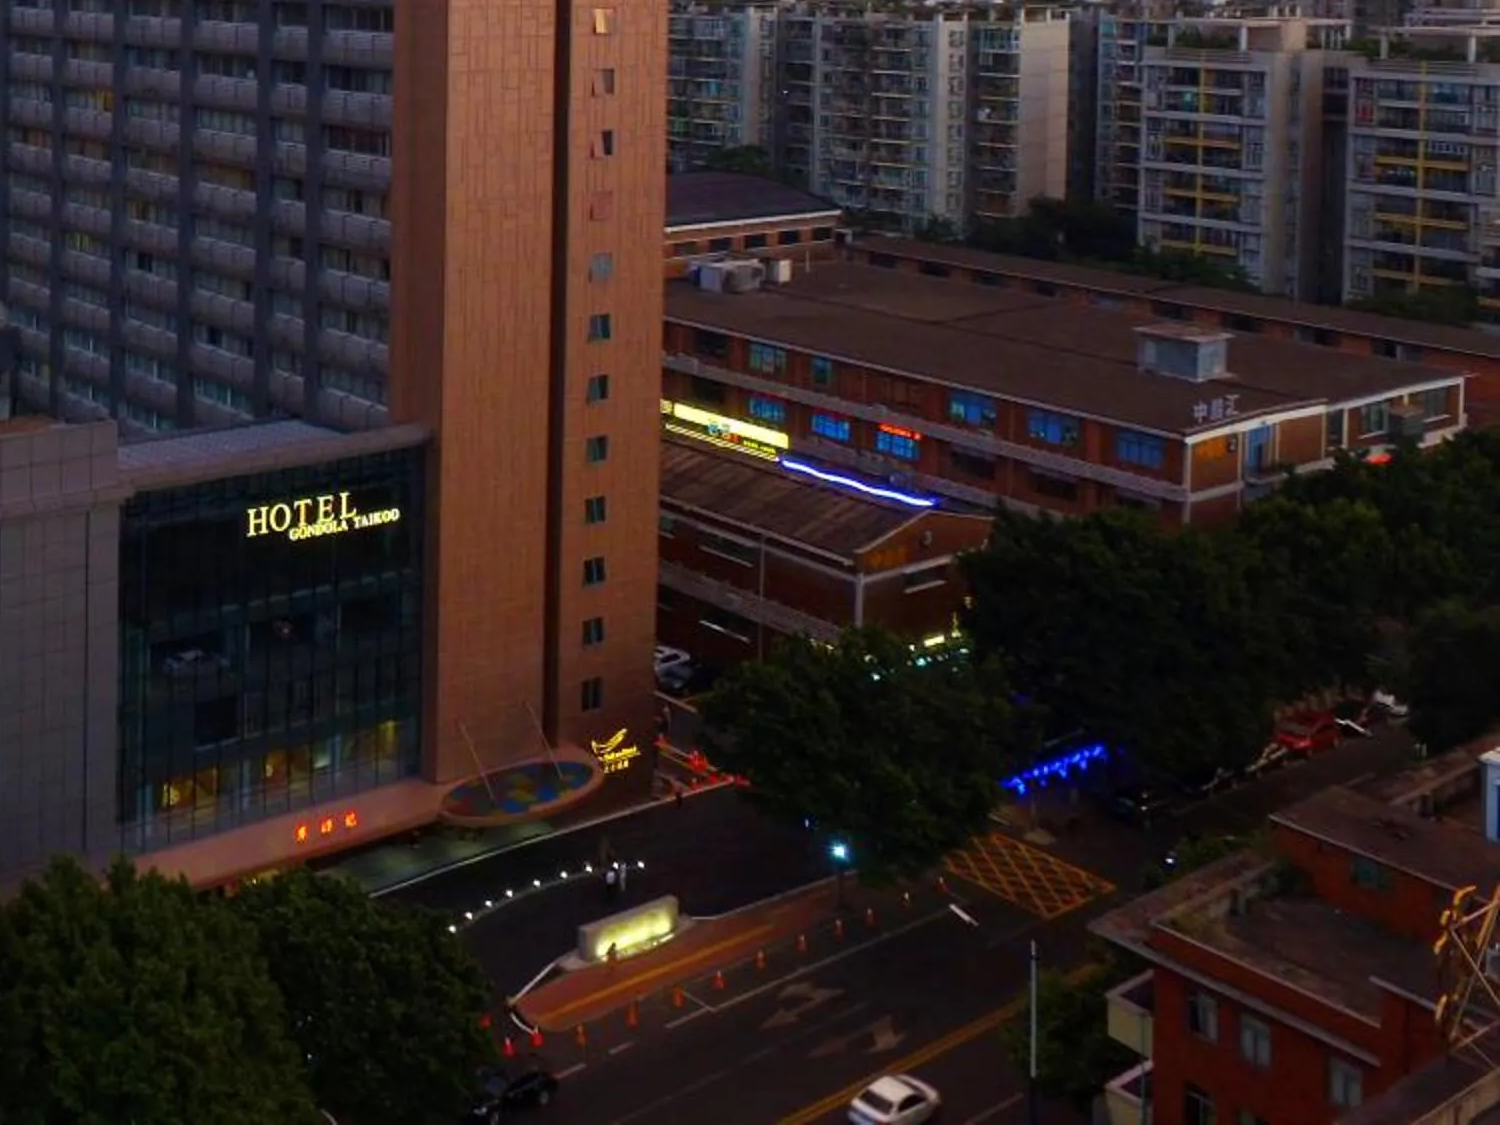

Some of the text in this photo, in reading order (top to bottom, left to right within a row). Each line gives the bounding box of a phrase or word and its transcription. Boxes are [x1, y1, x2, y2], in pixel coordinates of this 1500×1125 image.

[246, 491, 357, 537] HOTEL
[288, 508, 400, 541] GONDOLA TAIKOO
